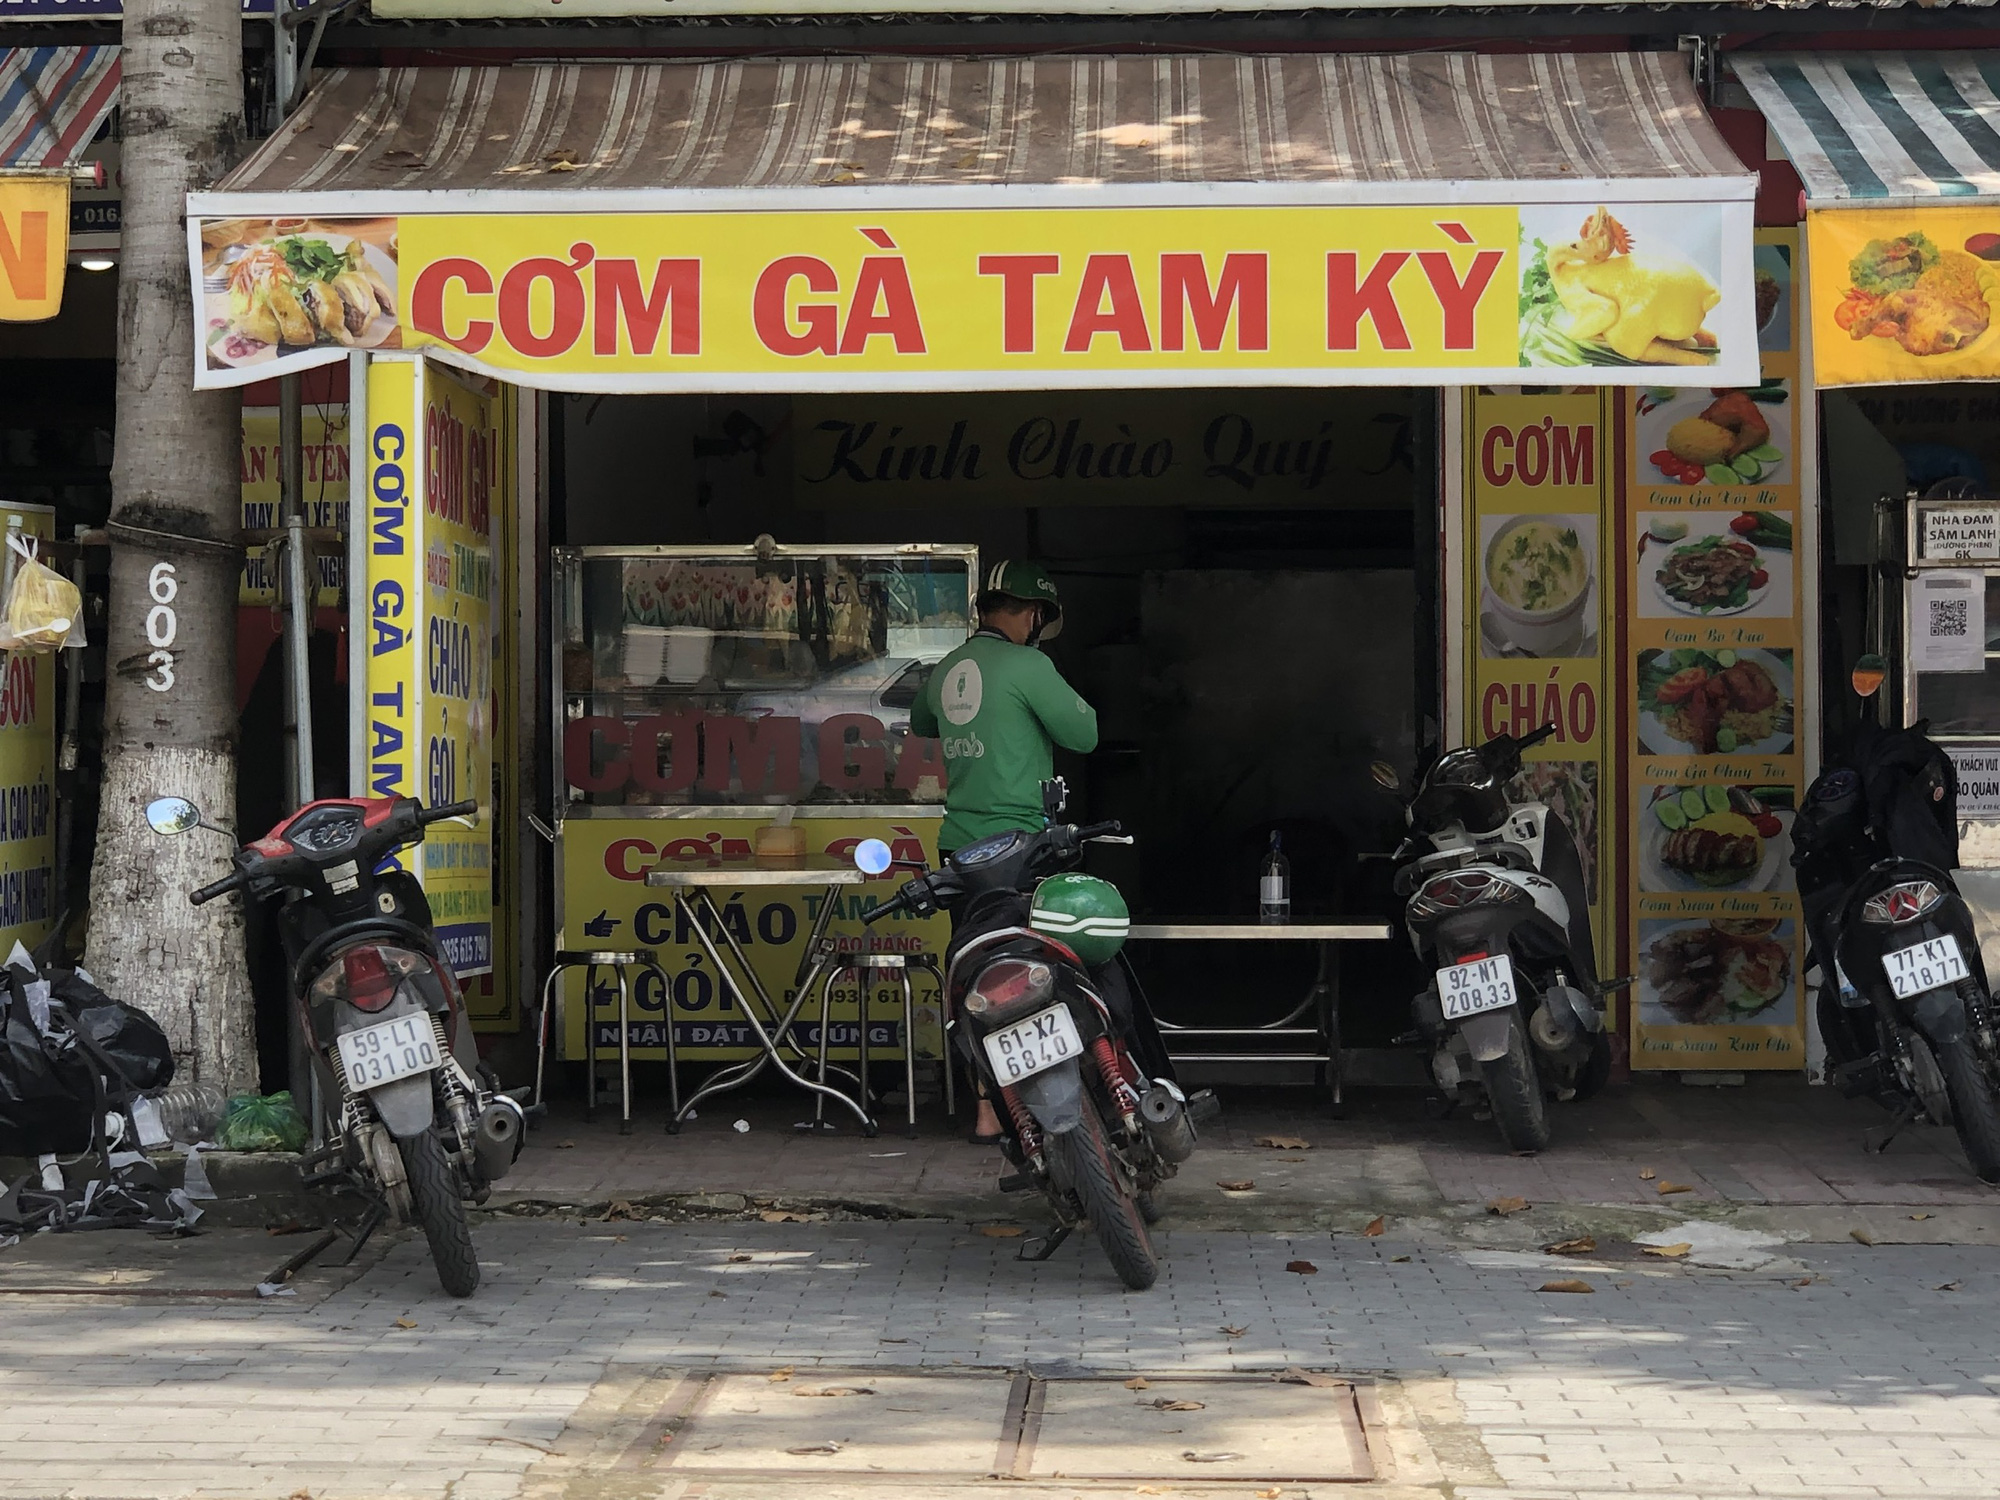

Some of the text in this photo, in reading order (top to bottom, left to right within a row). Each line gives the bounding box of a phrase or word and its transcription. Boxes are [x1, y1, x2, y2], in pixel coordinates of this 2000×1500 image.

[411, 222, 1504, 358] CƠM GÀ TAM KỲ
[426, 394, 463, 527] CƠM
[799, 419, 990, 484] Kính
[1006, 416, 1184, 482] Chào
[1201, 412, 1338, 490] Quý
[1481, 415, 1595, 488] CƠM
[373, 423, 409, 555] CƠM
[1929, 528, 1996, 542] SÂM LẠNH
[1932, 514, 1994, 525] NHA ĐAM
[1955, 550, 1972, 559] 6K
[146, 562, 178, 692] 603
[373, 579, 412, 658] GÀ
[429, 600, 471, 701] CHÁO
[1482, 666, 1597, 744] CHÁO
[429, 707, 456, 809] GỎI
[943, 731, 985, 760] Grab
[1960, 754, 1984, 771] KHÁCH
[634, 891, 798, 946] CHÁO
[870, 932, 922, 952] HÀNG
[1893, 939, 1947, 971] 77-K1
[1449, 960, 1499, 991] 92-N1
[1894, 957, 1961, 995] 218.77
[1447, 981, 1511, 1016] 208.33
[353, 1020, 416, 1057] 59-L1
[691, 1023, 750, 1047] ĐẶT
[998, 1013, 1060, 1055] 61-X2
[352, 1042, 434, 1085] 031.00
